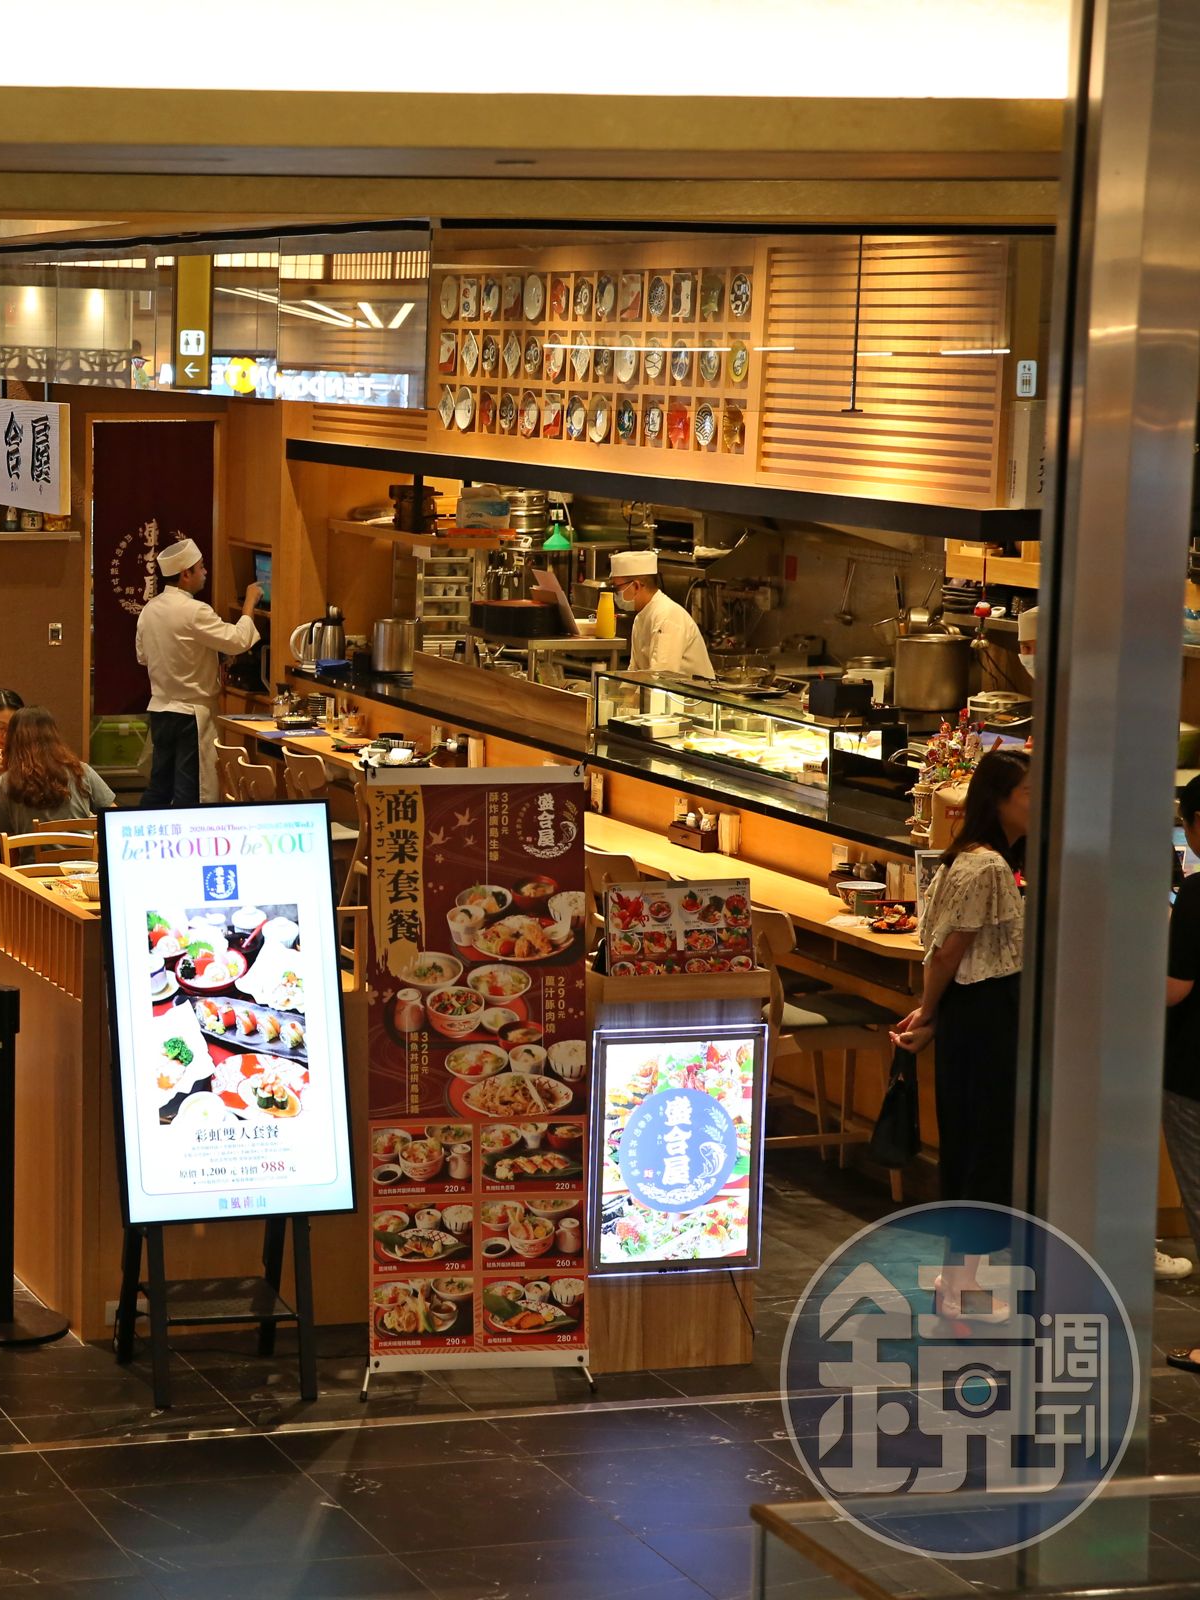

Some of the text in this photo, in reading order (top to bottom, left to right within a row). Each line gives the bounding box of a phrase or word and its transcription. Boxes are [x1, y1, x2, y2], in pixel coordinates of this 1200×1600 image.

[501, 792, 509, 835] 320元
[537, 793, 555, 847] 盛合屋
[122, 823, 182, 838] 微風彩虹節
[375, 790, 386, 879] ランチコース
[121, 832, 314, 861] bePROUD beYOU
[386, 789, 420, 944] 商業套餐
[557, 976, 566, 1019] 290元
[421, 1032, 429, 1075] 320元
[195, 1124, 279, 1143] 彩虹雙人套餐
[662, 1096, 693, 1185] 盛合屋
[200, 1167, 227, 1177] 1,200
[261, 1160, 285, 1173] 988
[444, 1185, 459, 1193] 220
[555, 1182, 570, 1190] 220
[218, 1195, 267, 1211] 微風南山
[445, 1263, 460, 1271] 270
[446, 1338, 460, 1346] 290
